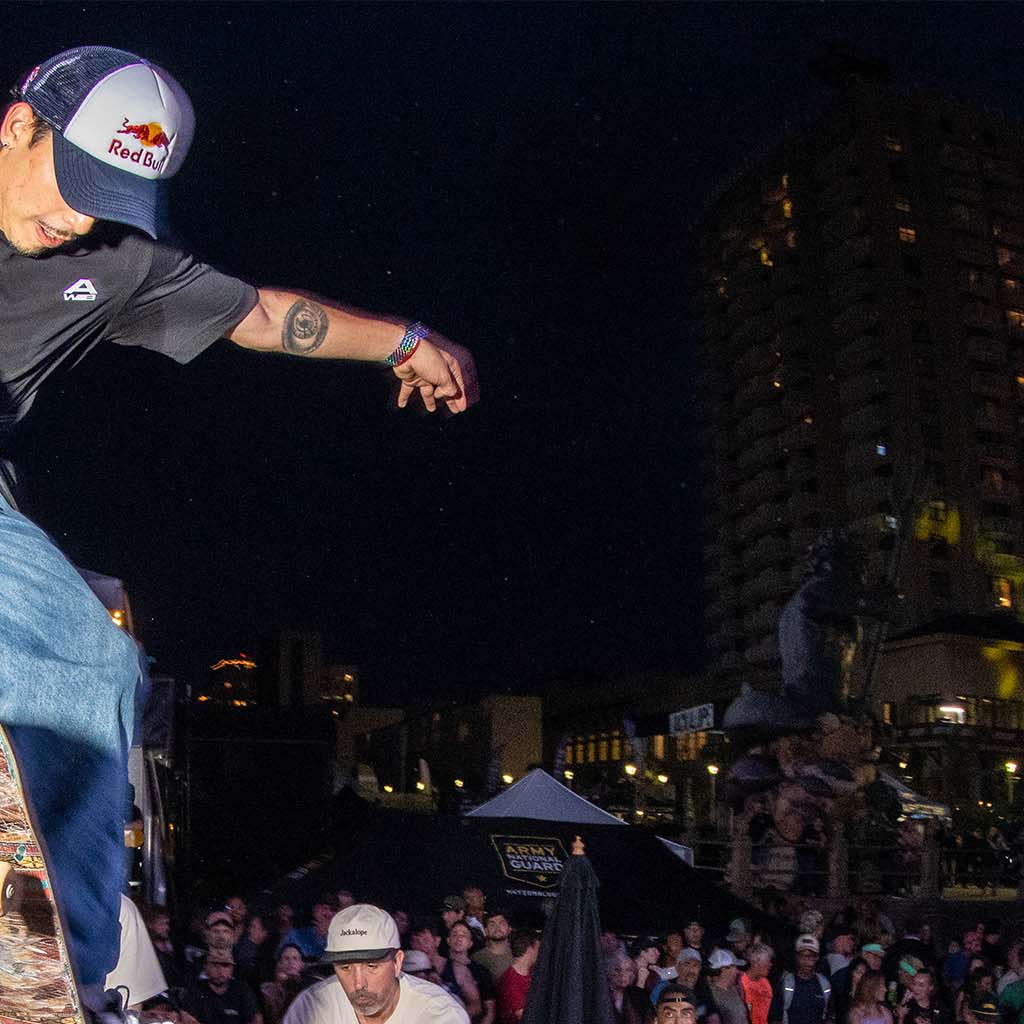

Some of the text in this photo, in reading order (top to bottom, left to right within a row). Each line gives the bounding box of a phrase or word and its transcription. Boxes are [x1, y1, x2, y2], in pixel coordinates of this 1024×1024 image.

[107, 138, 144, 164] Red
[504, 845, 556, 856] ARMY
[339, 928, 368, 937] Jackalope
